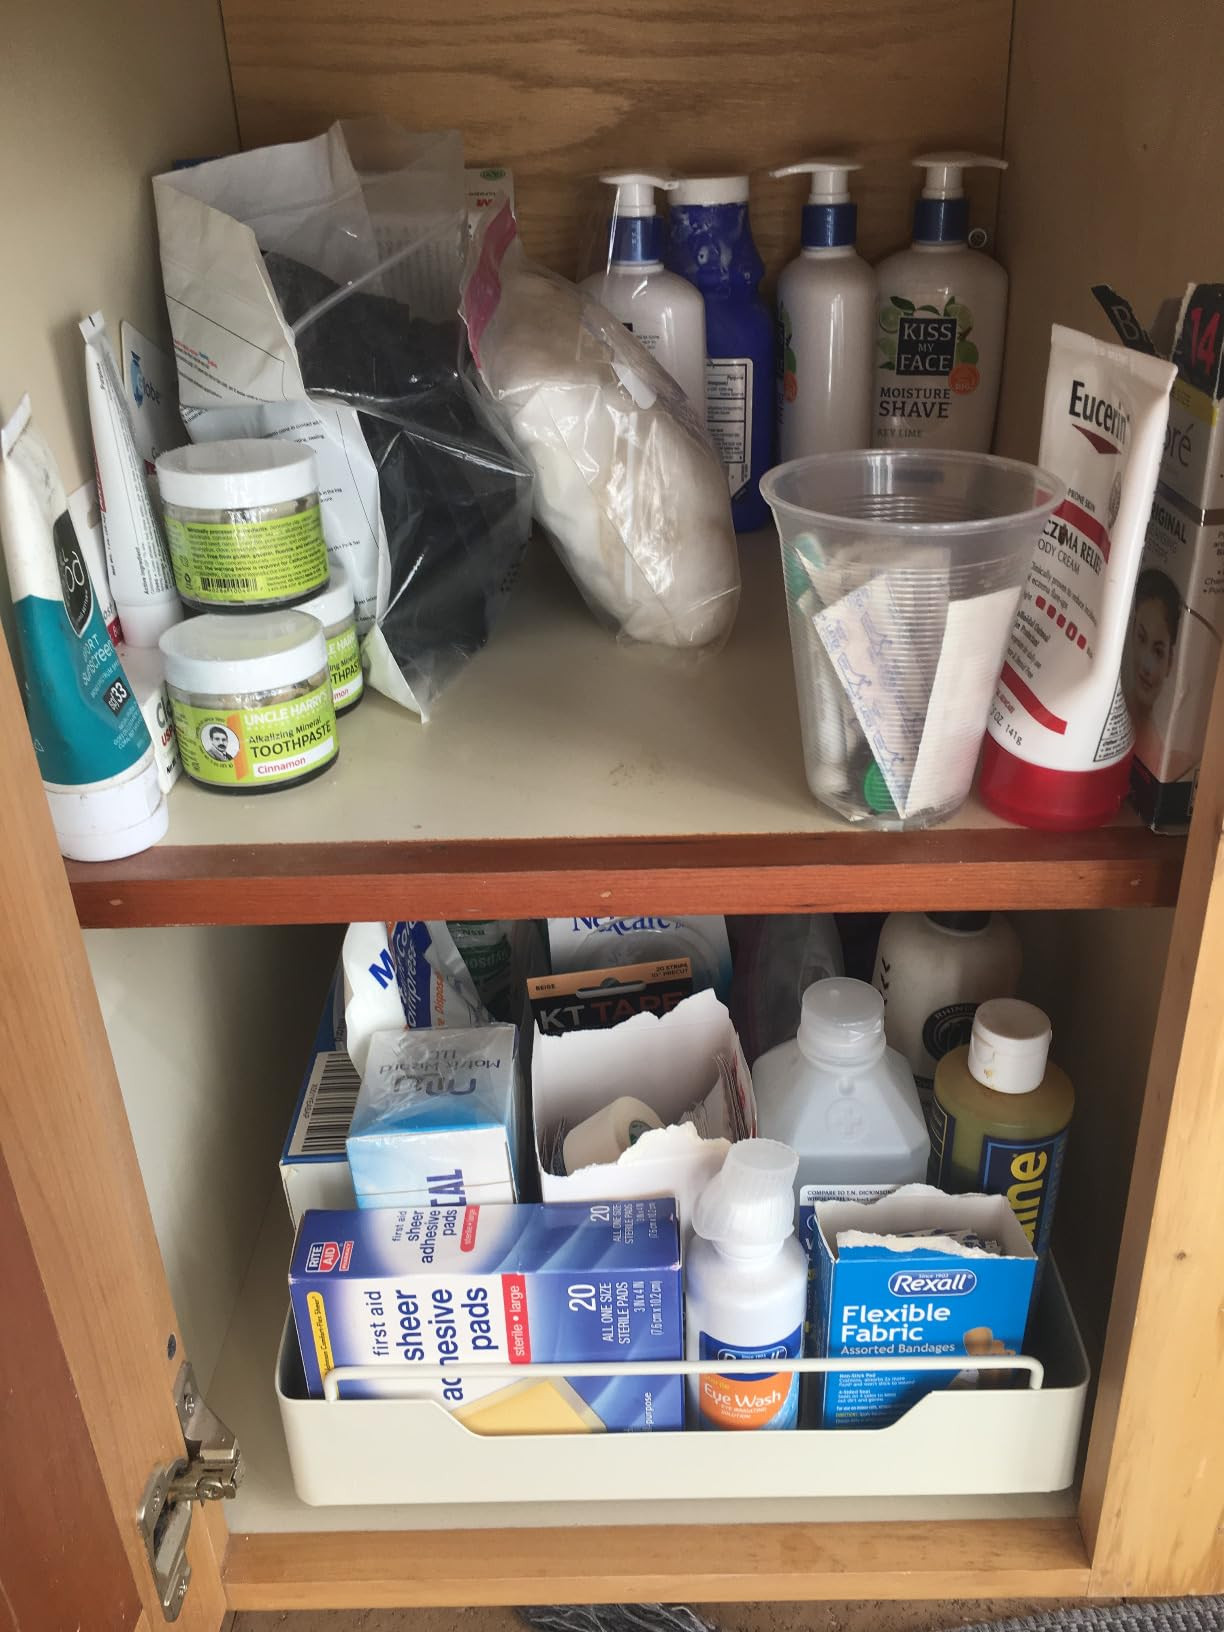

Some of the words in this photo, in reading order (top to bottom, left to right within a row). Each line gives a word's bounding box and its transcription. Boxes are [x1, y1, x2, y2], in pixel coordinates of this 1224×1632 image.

[903, 323, 952, 341] KISS
[1190, 307, 1222, 376] 14
[918, 343, 934, 352] MY
[900, 355, 951, 371] FACE
[880, 387, 951, 399] MOISTURE
[879, 401, 952, 418] SHAVE
[1069, 380, 1128, 445] Eucerin
[1151, 502, 1186, 543] RIGINAL
[1038, 539, 1056, 556] ODY
[1058, 550, 1080, 575] CREAM
[114, 682, 128, 704] 33
[244, 709, 290, 726] UNCLE
[249, 728, 294, 744] Alkalizing
[295, 716, 321, 734] Mineral
[250, 719, 332, 758] TOOTHPASTE
[257, 756, 306, 775] Cinnamon
[535, 983, 556, 991] BEIGE
[539, 1005, 585, 1030] KT
[396, 1211, 407, 1222] aid
[442, 1209, 458, 1236] pads
[590, 1205, 610, 1222] 20
[392, 1224, 404, 1242] first
[405, 1210, 424, 1242] sheer
[419, 1210, 441, 1264] adhesive
[612, 1230, 622, 1242] ALL
[624, 1219, 634, 1244] STERILE
[309, 1246, 323, 1268] RITE
[322, 1246, 336, 1266] AID
[599, 1282, 612, 1303] SIZE
[893, 1273, 967, 1293] Rexall
[364, 1291, 385, 1316] aid
[509, 1285, 524, 1313] large
[568, 1283, 597, 1312] 20
[615, 1282, 629, 1307] PADS
[461, 1287, 499, 1351] pads
[600, 1304, 613, 1324] ONE
[842, 1303, 951, 1323] Flexible
[395, 1289, 425, 1361] sheer
[602, 1328, 614, 1342] ALL
[617, 1308, 631, 1344] STERILE
[841, 1323, 924, 1343] Fabric
[370, 1322, 390, 1356] first
[511, 1323, 525, 1357] sterile
[841, 1344, 898, 1355] Assorted
[898, 1343, 956, 1354] Bandages
[704, 1383, 731, 1406] Eye
[735, 1389, 782, 1408] Wash
